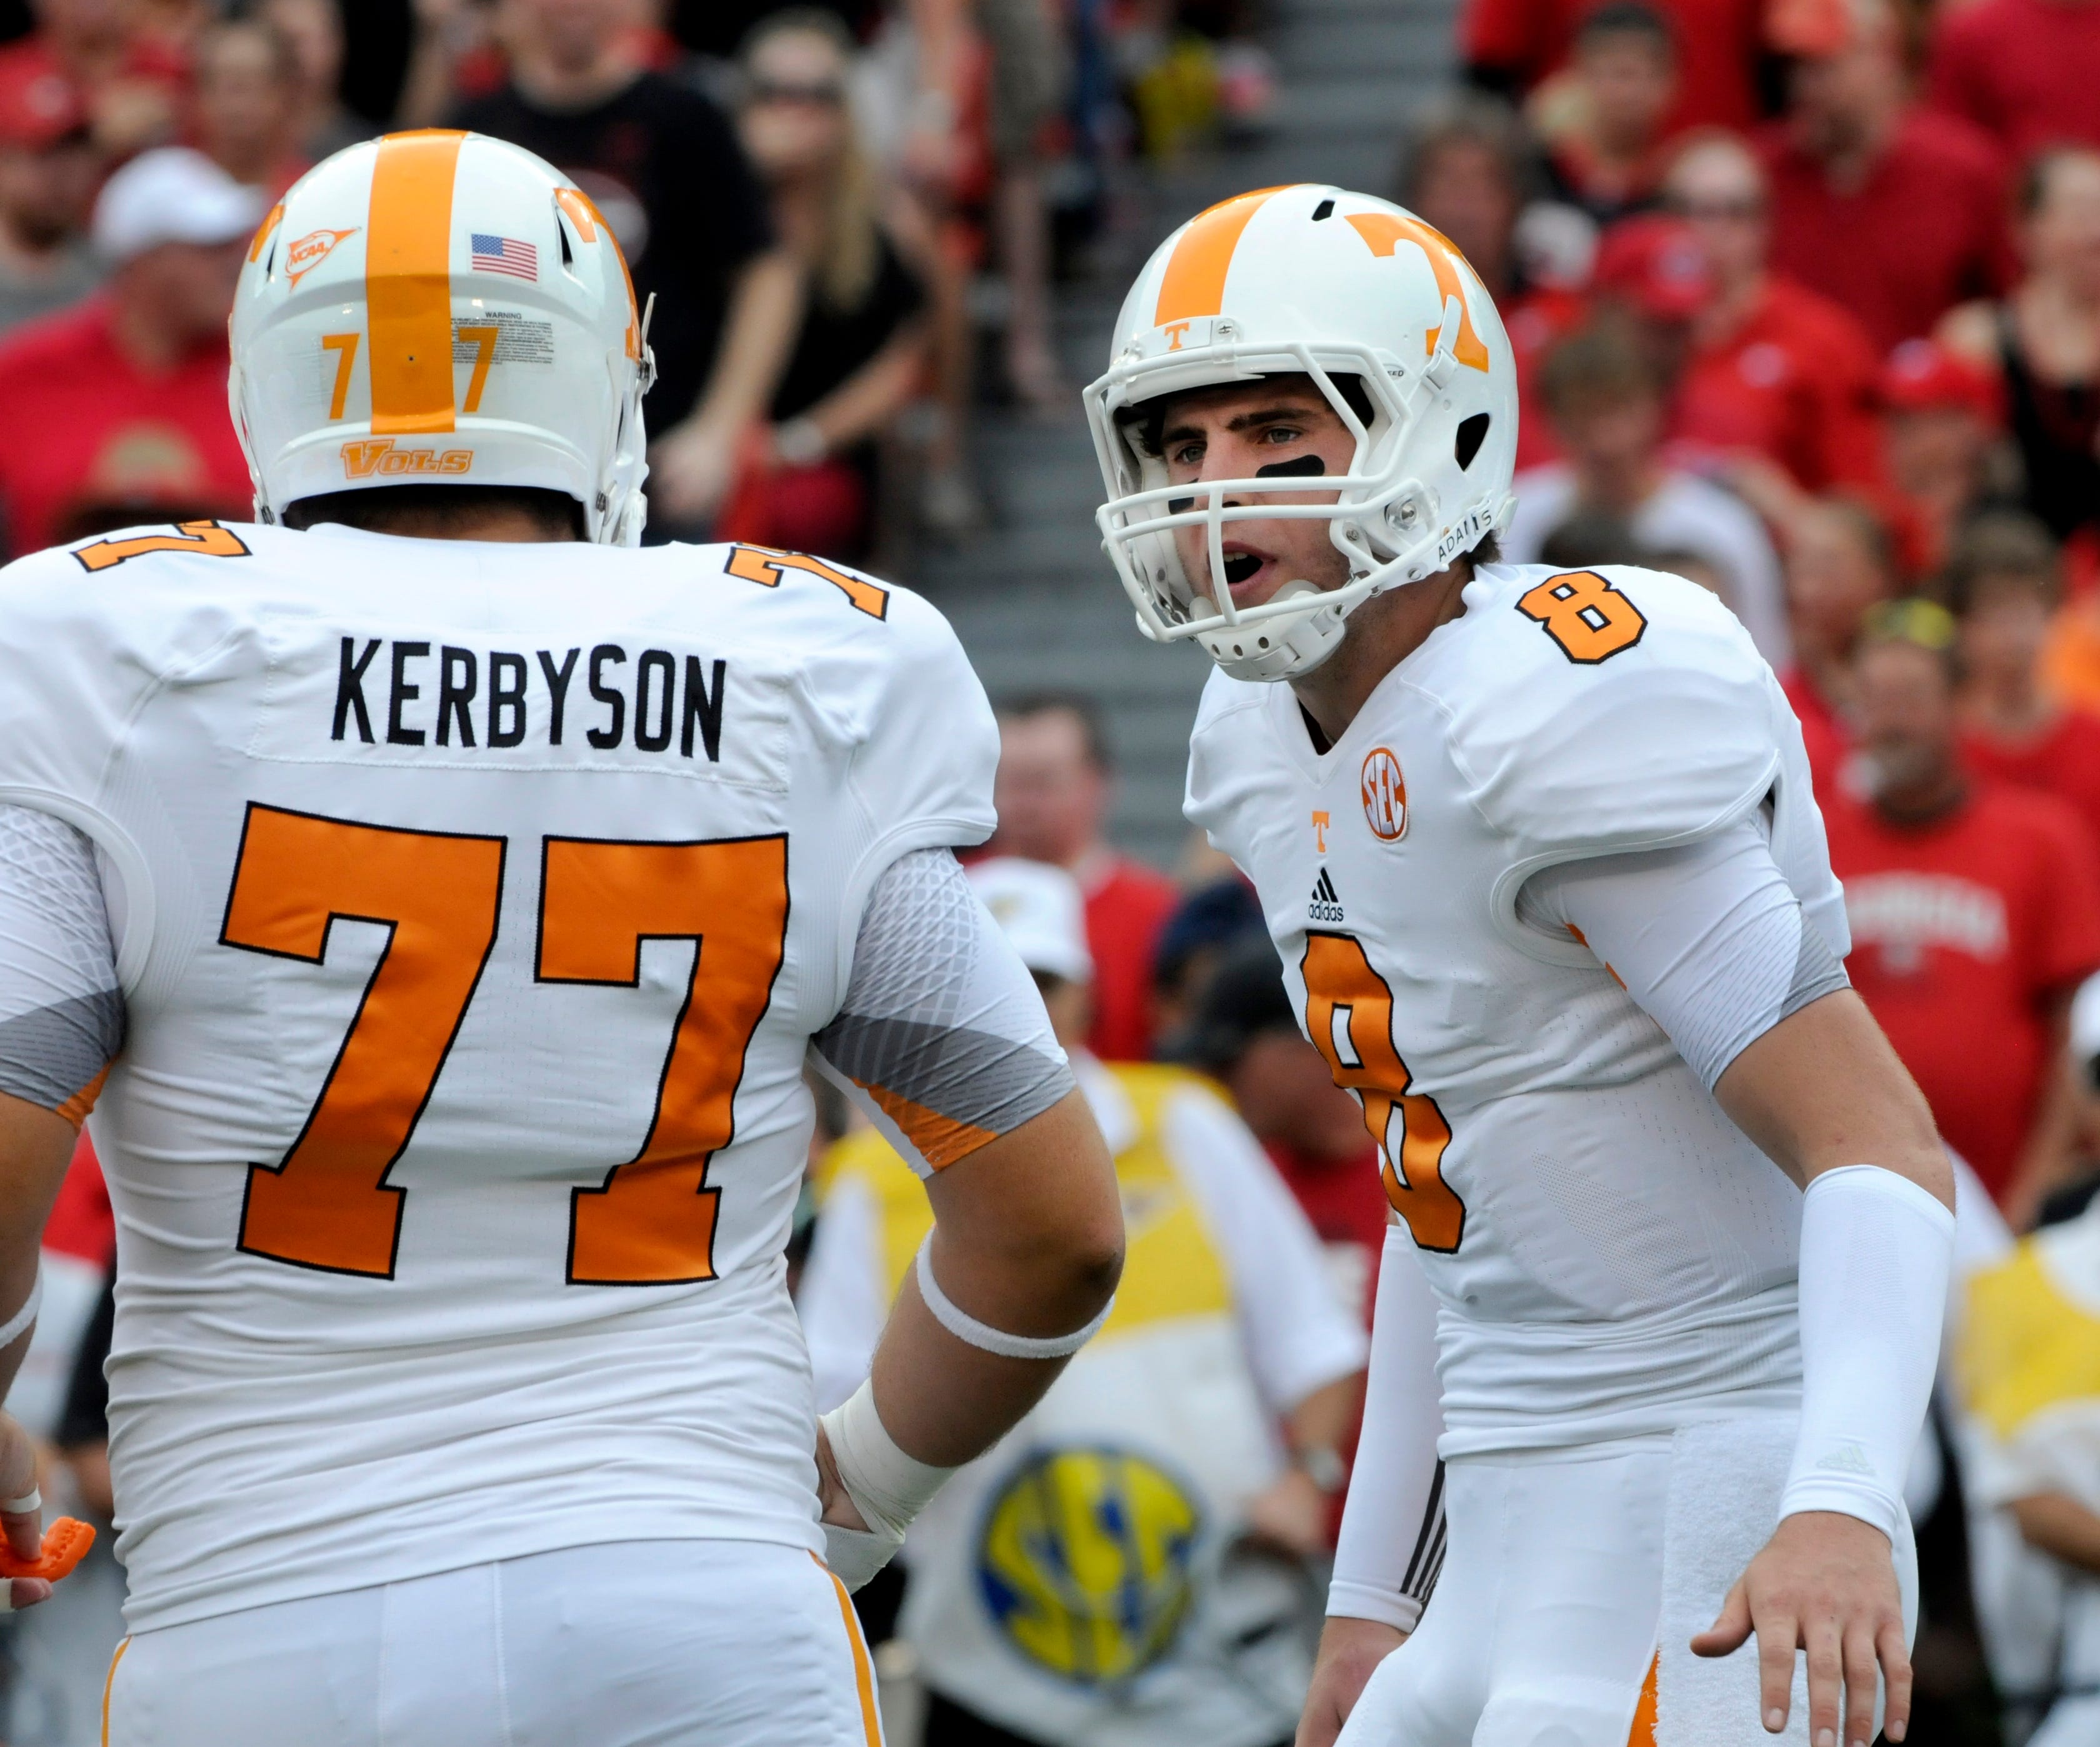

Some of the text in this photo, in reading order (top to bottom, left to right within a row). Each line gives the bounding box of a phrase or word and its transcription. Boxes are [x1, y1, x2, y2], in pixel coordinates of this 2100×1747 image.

[485, 311, 522, 319] WARNING
[1164, 321, 1190, 351] T
[1343, 213, 1489, 374] T
[322, 333, 361, 420] 7
[458, 327, 499, 413] 7
[1514, 571, 1648, 664] 8
[331, 636, 726, 763] KERBYSON
[1312, 811, 1329, 853] T
[1362, 752, 1406, 836] SEC
[1308, 901, 1344, 922] adidas
[218, 801, 790, 1286] 77
[1300, 929, 1466, 1254] 8
